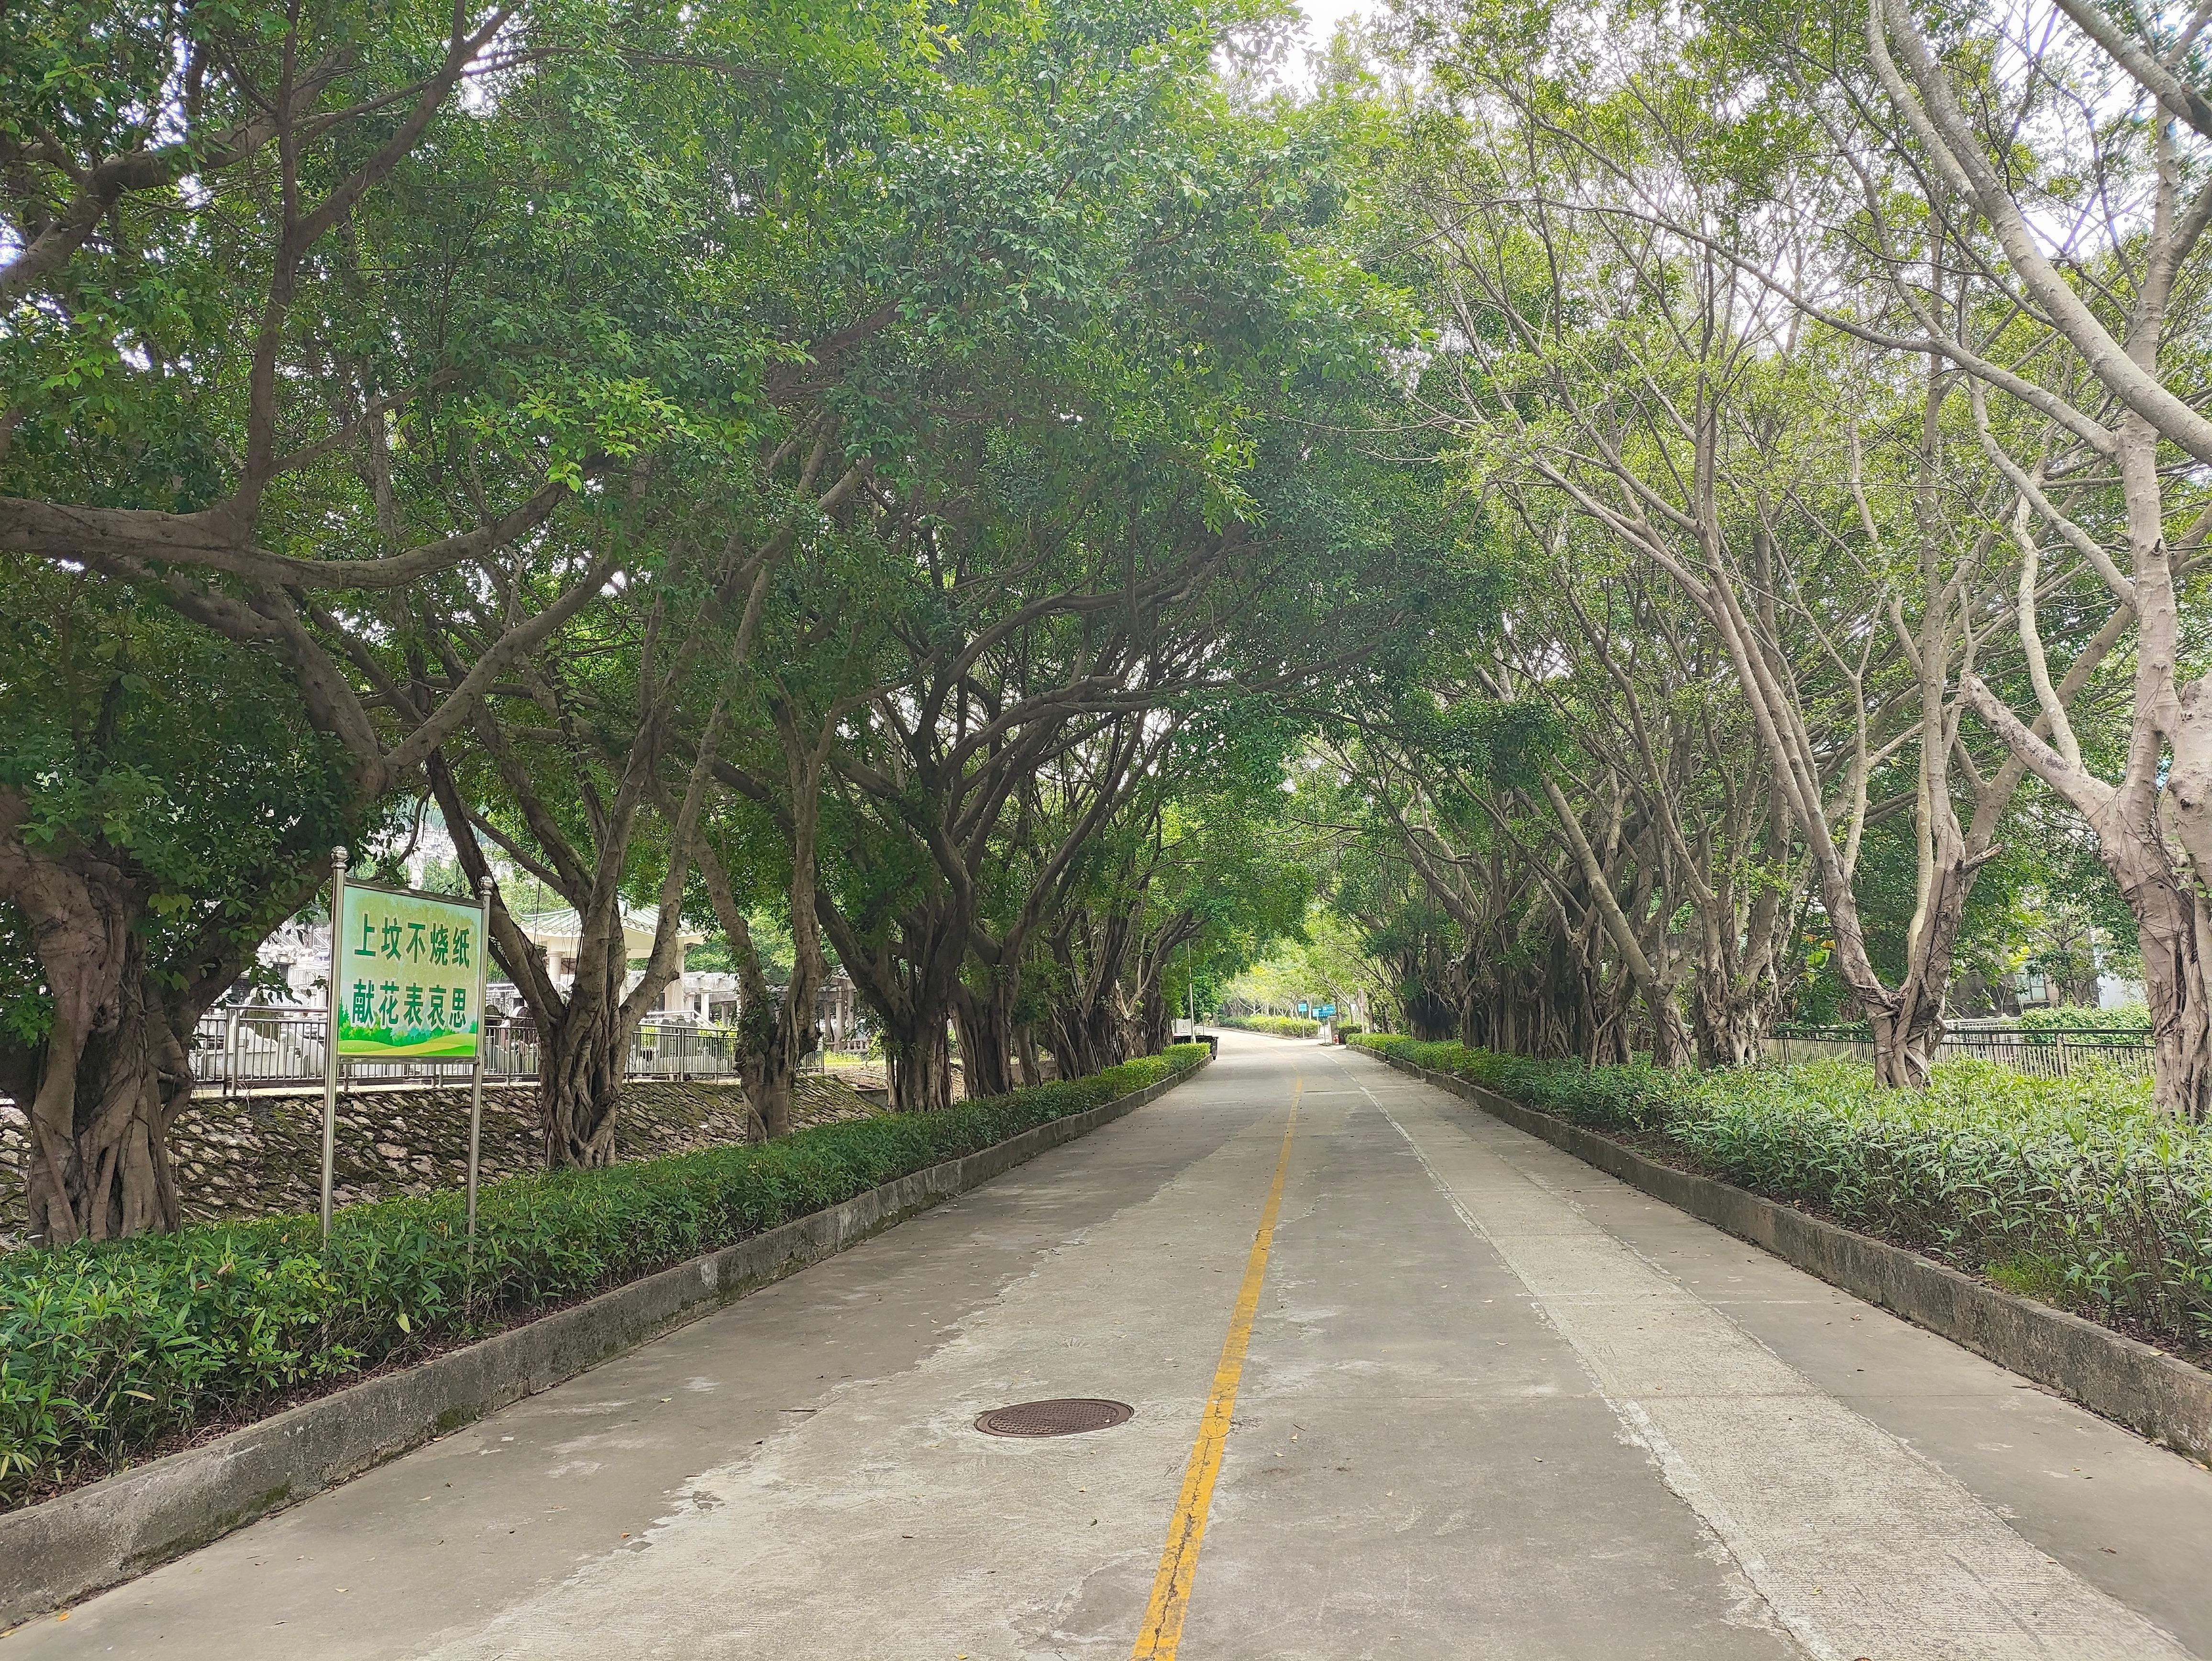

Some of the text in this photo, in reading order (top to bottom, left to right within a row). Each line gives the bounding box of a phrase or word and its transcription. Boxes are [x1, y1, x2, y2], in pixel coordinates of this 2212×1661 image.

[354, 913, 470, 969] 上坟不烧纸
[352, 979, 466, 1027] 献花表哀思
